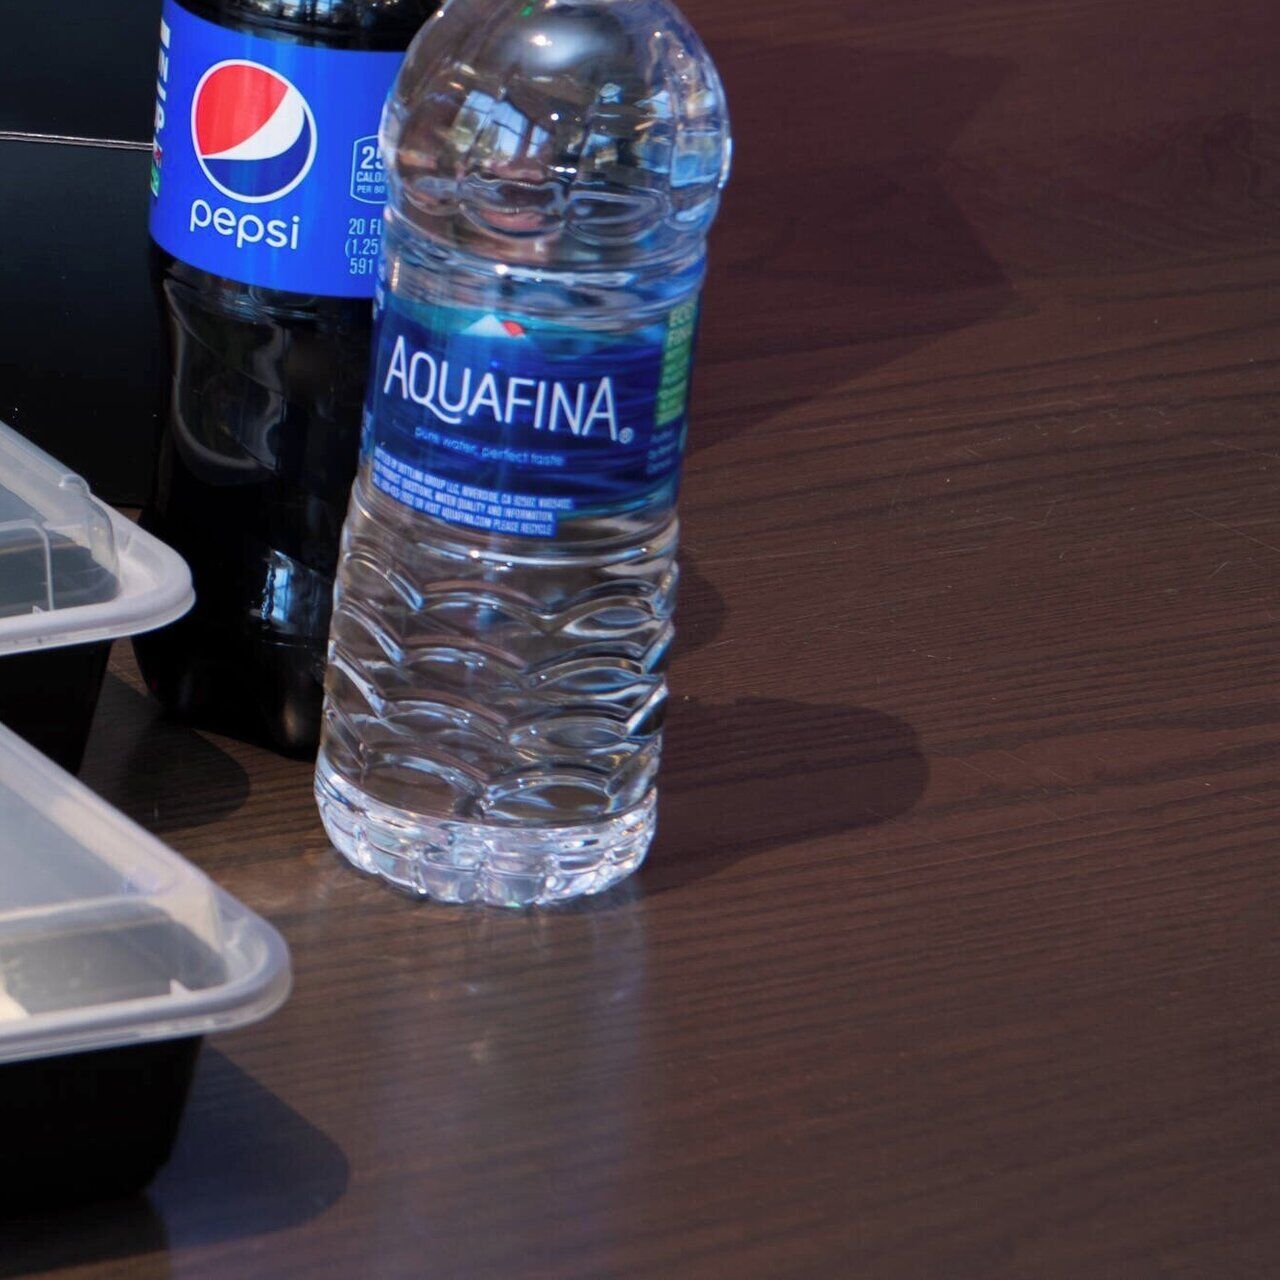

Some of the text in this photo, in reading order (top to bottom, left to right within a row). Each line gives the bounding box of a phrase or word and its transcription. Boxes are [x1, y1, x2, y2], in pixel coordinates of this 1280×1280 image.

[189, 197, 301, 251] pepsi
[348, 218, 365, 235] 20
[349, 258, 374, 275] 591
